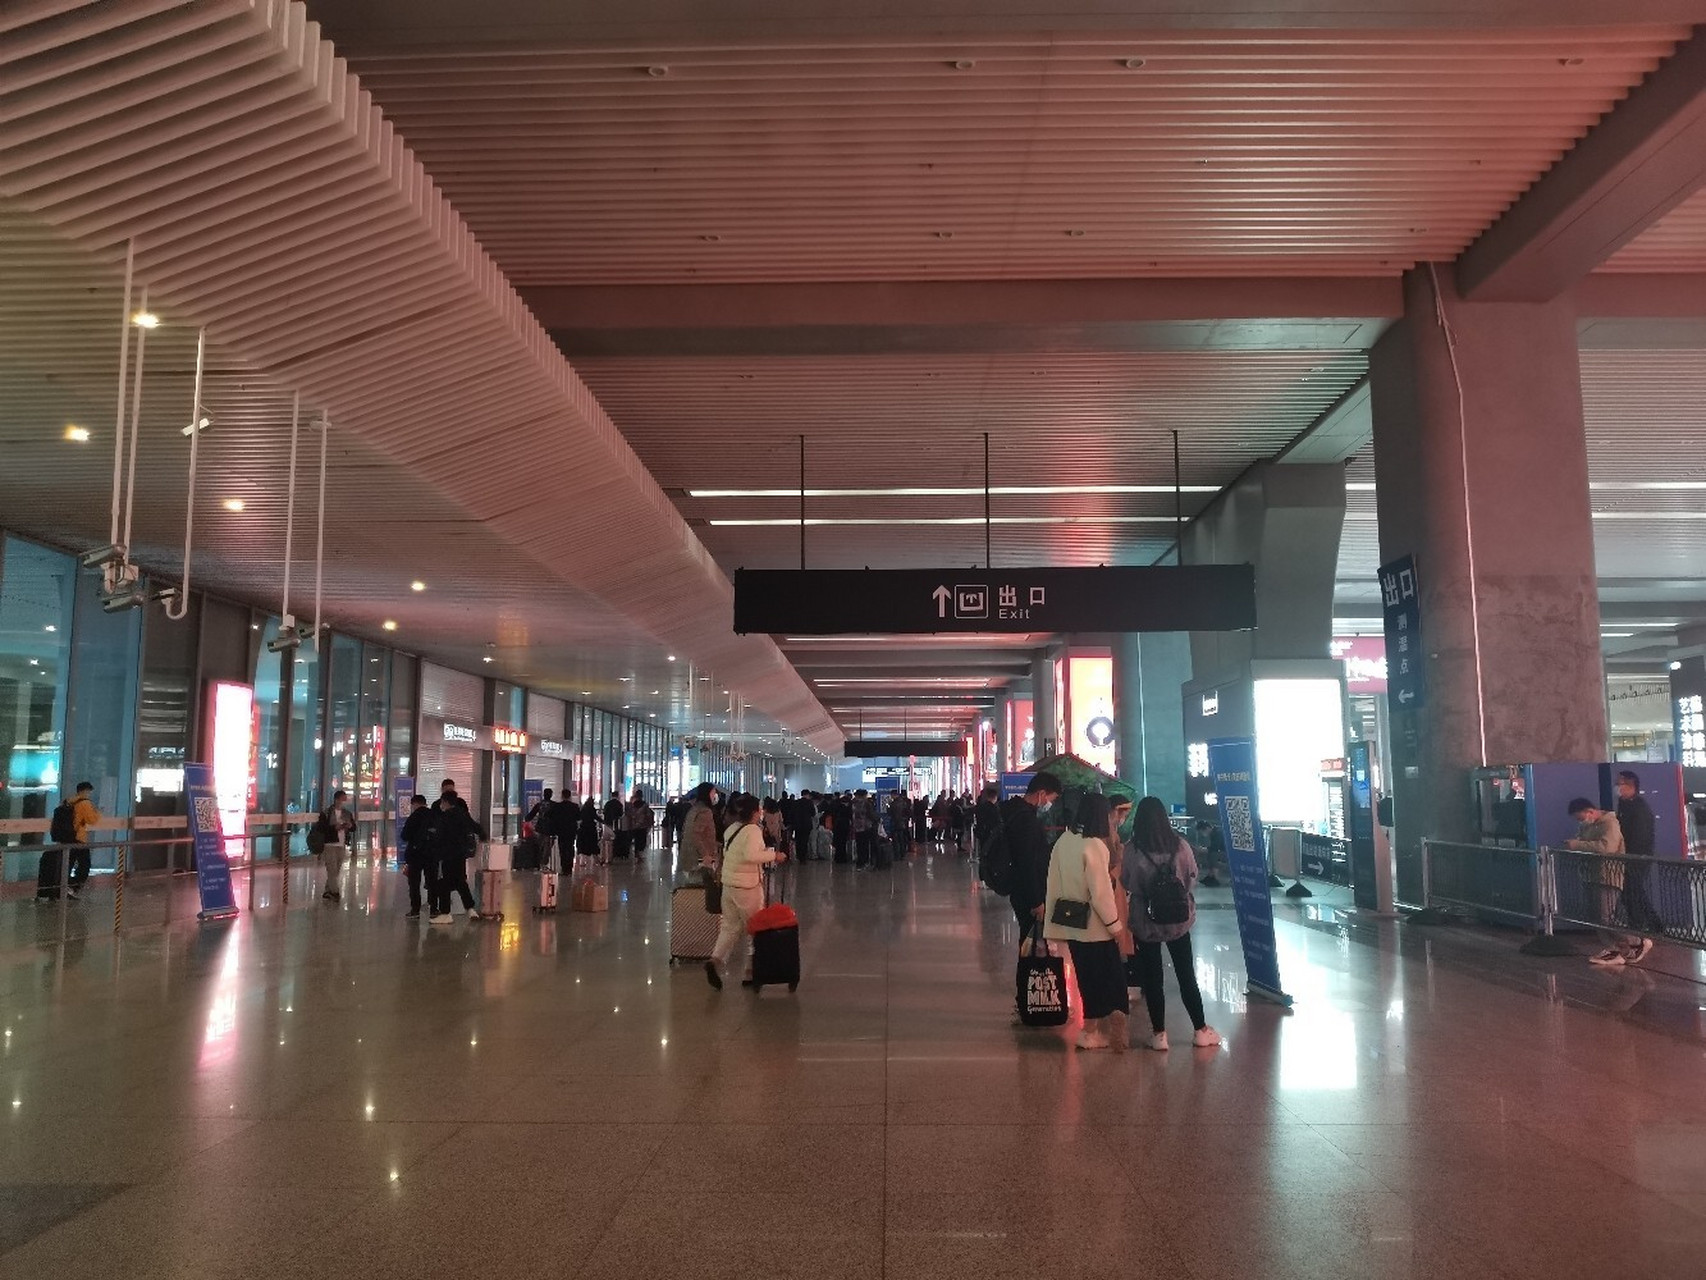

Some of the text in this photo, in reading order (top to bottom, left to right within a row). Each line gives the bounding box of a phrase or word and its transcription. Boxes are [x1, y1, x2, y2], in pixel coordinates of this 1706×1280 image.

[999, 585, 1045, 606] 出口
[1383, 570, 1414, 606] 出口
[999, 608, 1029, 619] Exit
[1027, 975, 1058, 991] POST
[1027, 989, 1062, 1006] MILK
